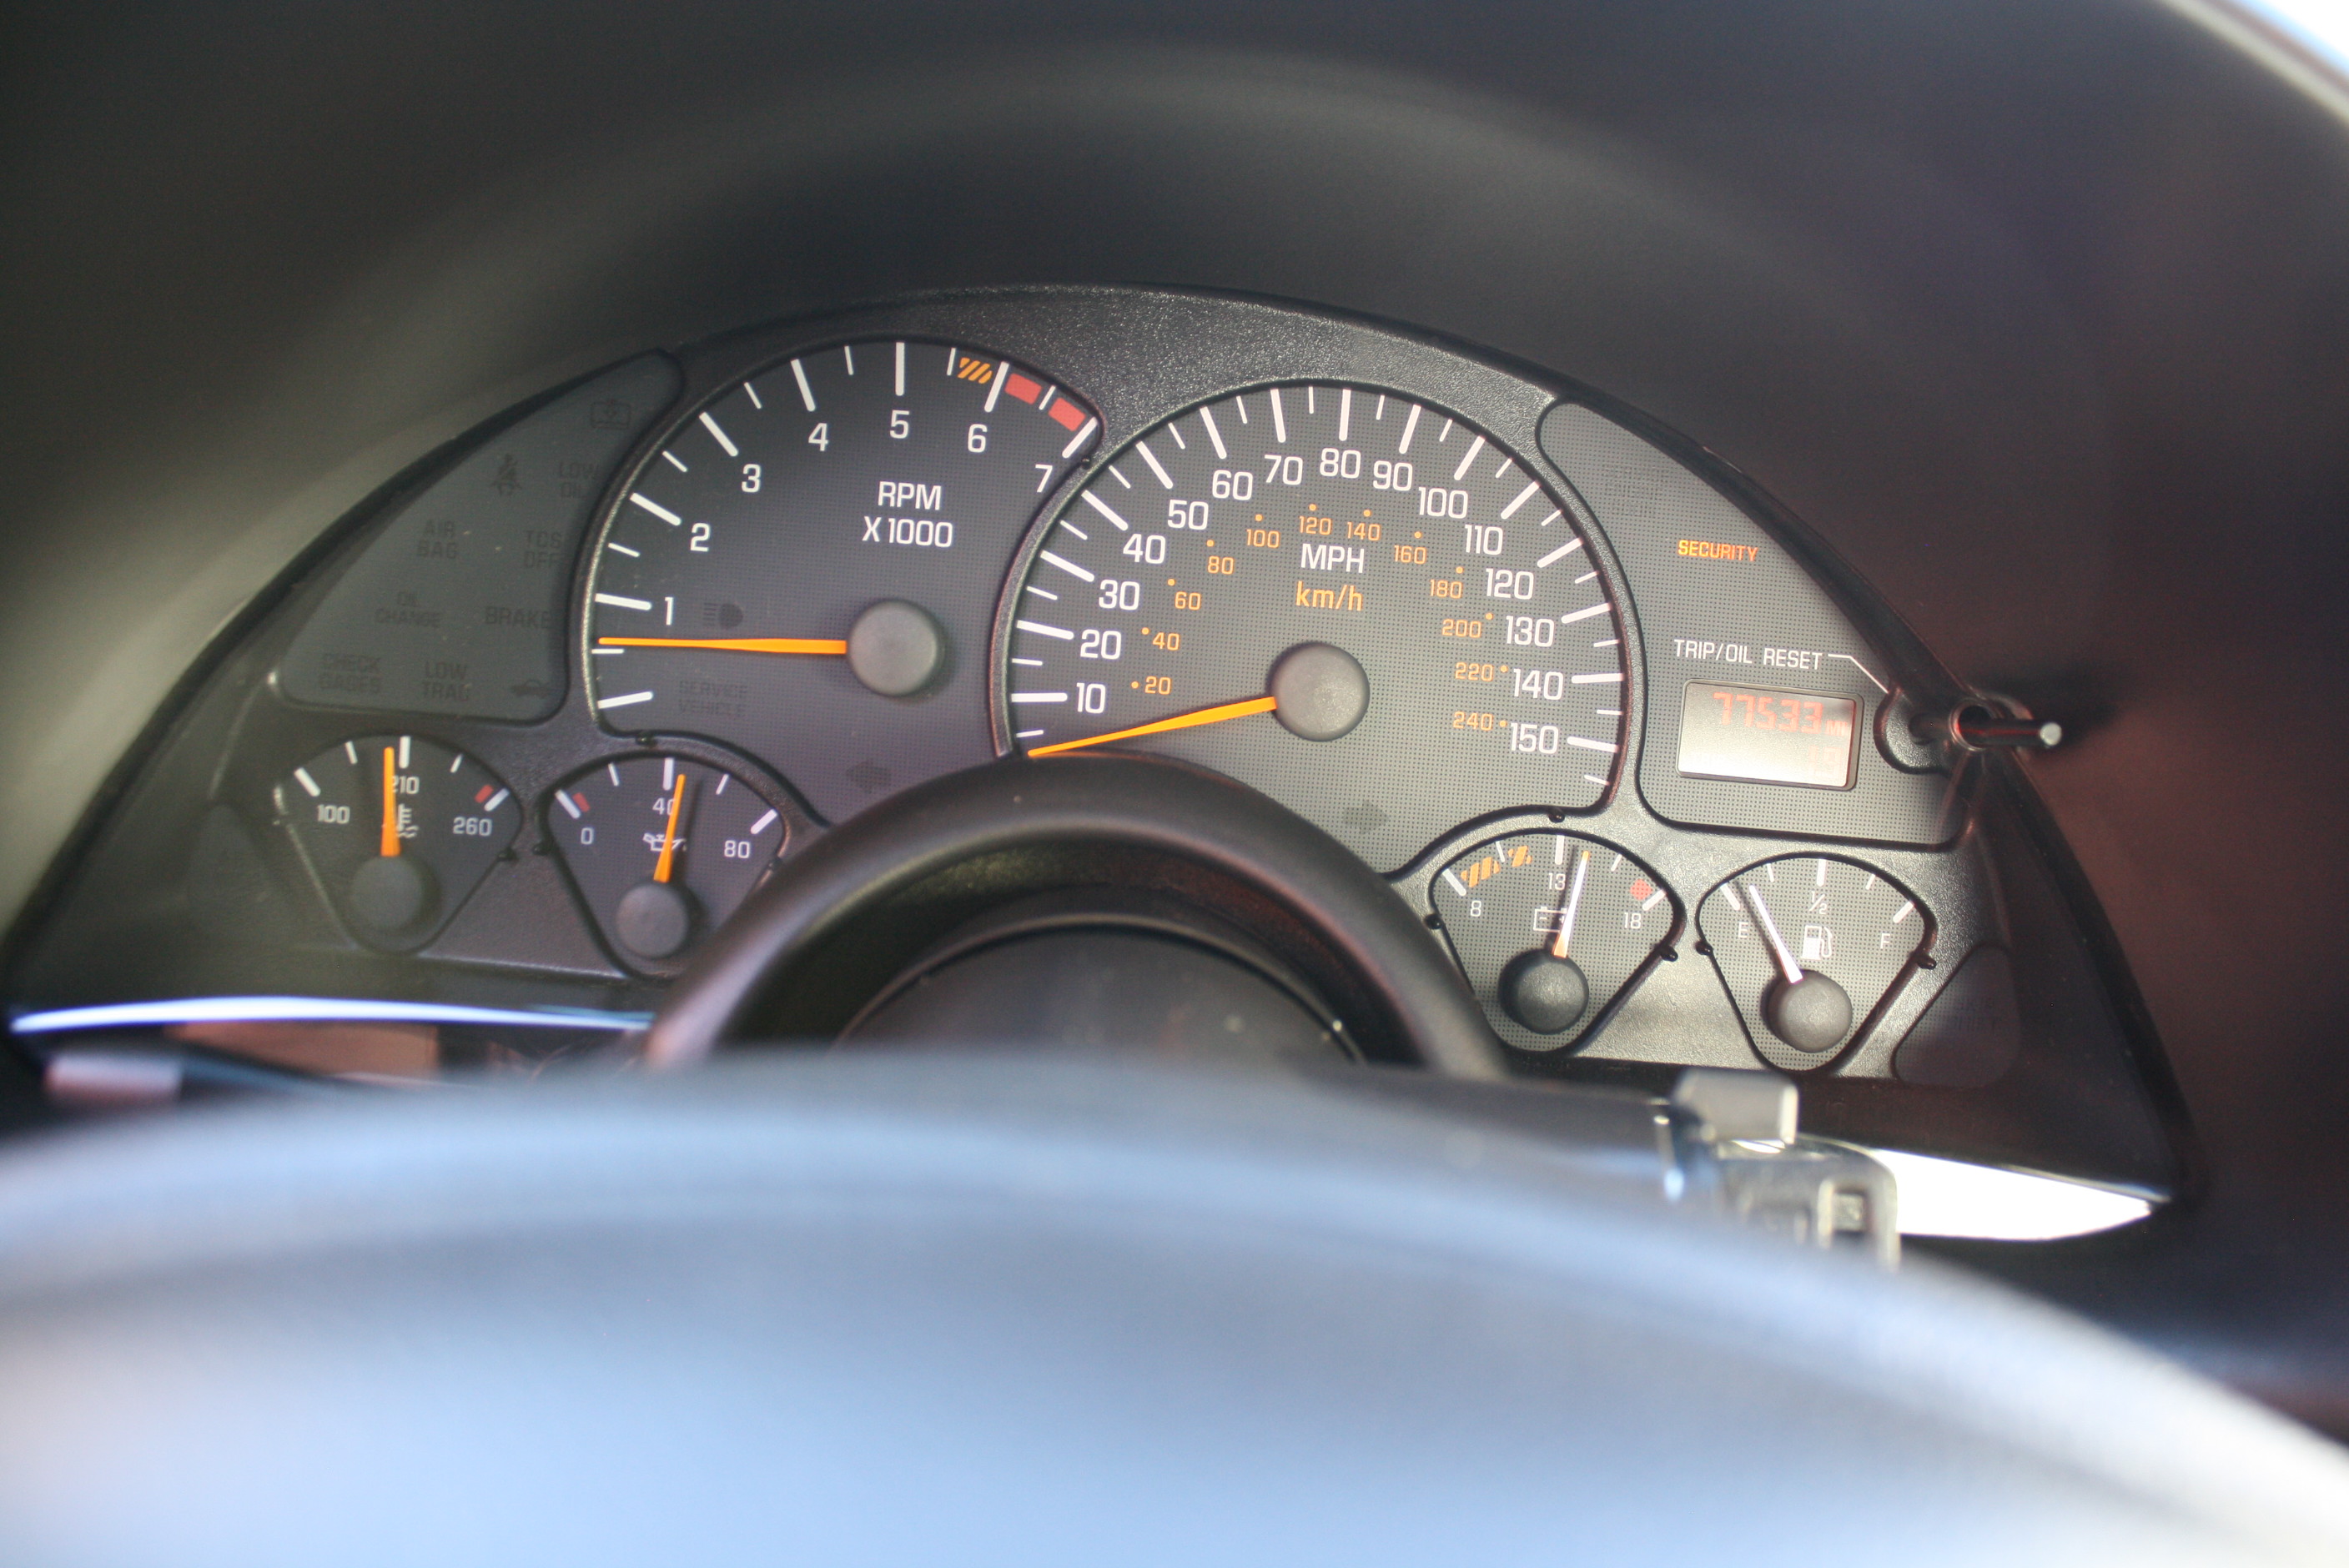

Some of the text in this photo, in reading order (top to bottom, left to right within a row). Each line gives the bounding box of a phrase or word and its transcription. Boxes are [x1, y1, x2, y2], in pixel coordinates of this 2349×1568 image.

[808, 422, 829, 452] 4
[889, 410, 910, 440] 5
[968, 424, 988, 454] 6
[1264, 454, 1304, 485] 70
[1319, 447, 1361, 479] 80
[1372, 460, 1413, 492] 90
[741, 464, 762, 493] 3
[1034, 464, 1054, 493] 7
[1211, 470, 1254, 501] 60
[878, 480, 942, 511] RPM
[1418, 486, 1469, 520] 100
[423, 519, 455, 539] AIR
[1167, 499, 1210, 530] 50
[1299, 515, 1333, 536] 120
[690, 522, 711, 552] 2
[1246, 528, 1281, 549] 100
[1347, 521, 1381, 541] 140
[1464, 524, 1503, 555] 110
[1122, 533, 1166, 565] 40
[1300, 543, 1365, 574] MPH
[1394, 545, 1427, 565] 160
[1677, 539, 1758, 561] SECURITY
[1207, 555, 1235, 575] 80
[1099, 579, 1140, 611] 30
[1295, 580, 1364, 611] km/h
[1430, 579, 1464, 600] 180
[1486, 568, 1534, 601] 120
[664, 596, 674, 626] 1
[1174, 591, 1202, 611] 60
[485, 606, 551, 629] BRAKE
[1441, 618, 1482, 639] 200
[1506, 615, 1555, 647] 130
[1079, 629, 1122, 660] 20
[1152, 631, 1181, 651] 40
[1673, 638, 1823, 671] TRIP/OIL RESET
[1144, 676, 1172, 696] 20
[1455, 661, 1495, 682] 220
[1513, 668, 1564, 701] 140
[1076, 682, 1106, 714] 10
[1713, 691, 1823, 734] 77533
[1452, 711, 1495, 731] 240
[1510, 722, 1559, 755] 150
[318, 804, 350, 824] 100
[453, 816, 492, 837] 260
[581, 827, 594, 845] 0
[724, 839, 751, 859] 80
[1548, 872, 1567, 890] 13
[1470, 900, 1482, 917] 8
[1624, 912, 1642, 929] 18
[1738, 920, 1748, 938] E
[1879, 932, 1891, 949] F
